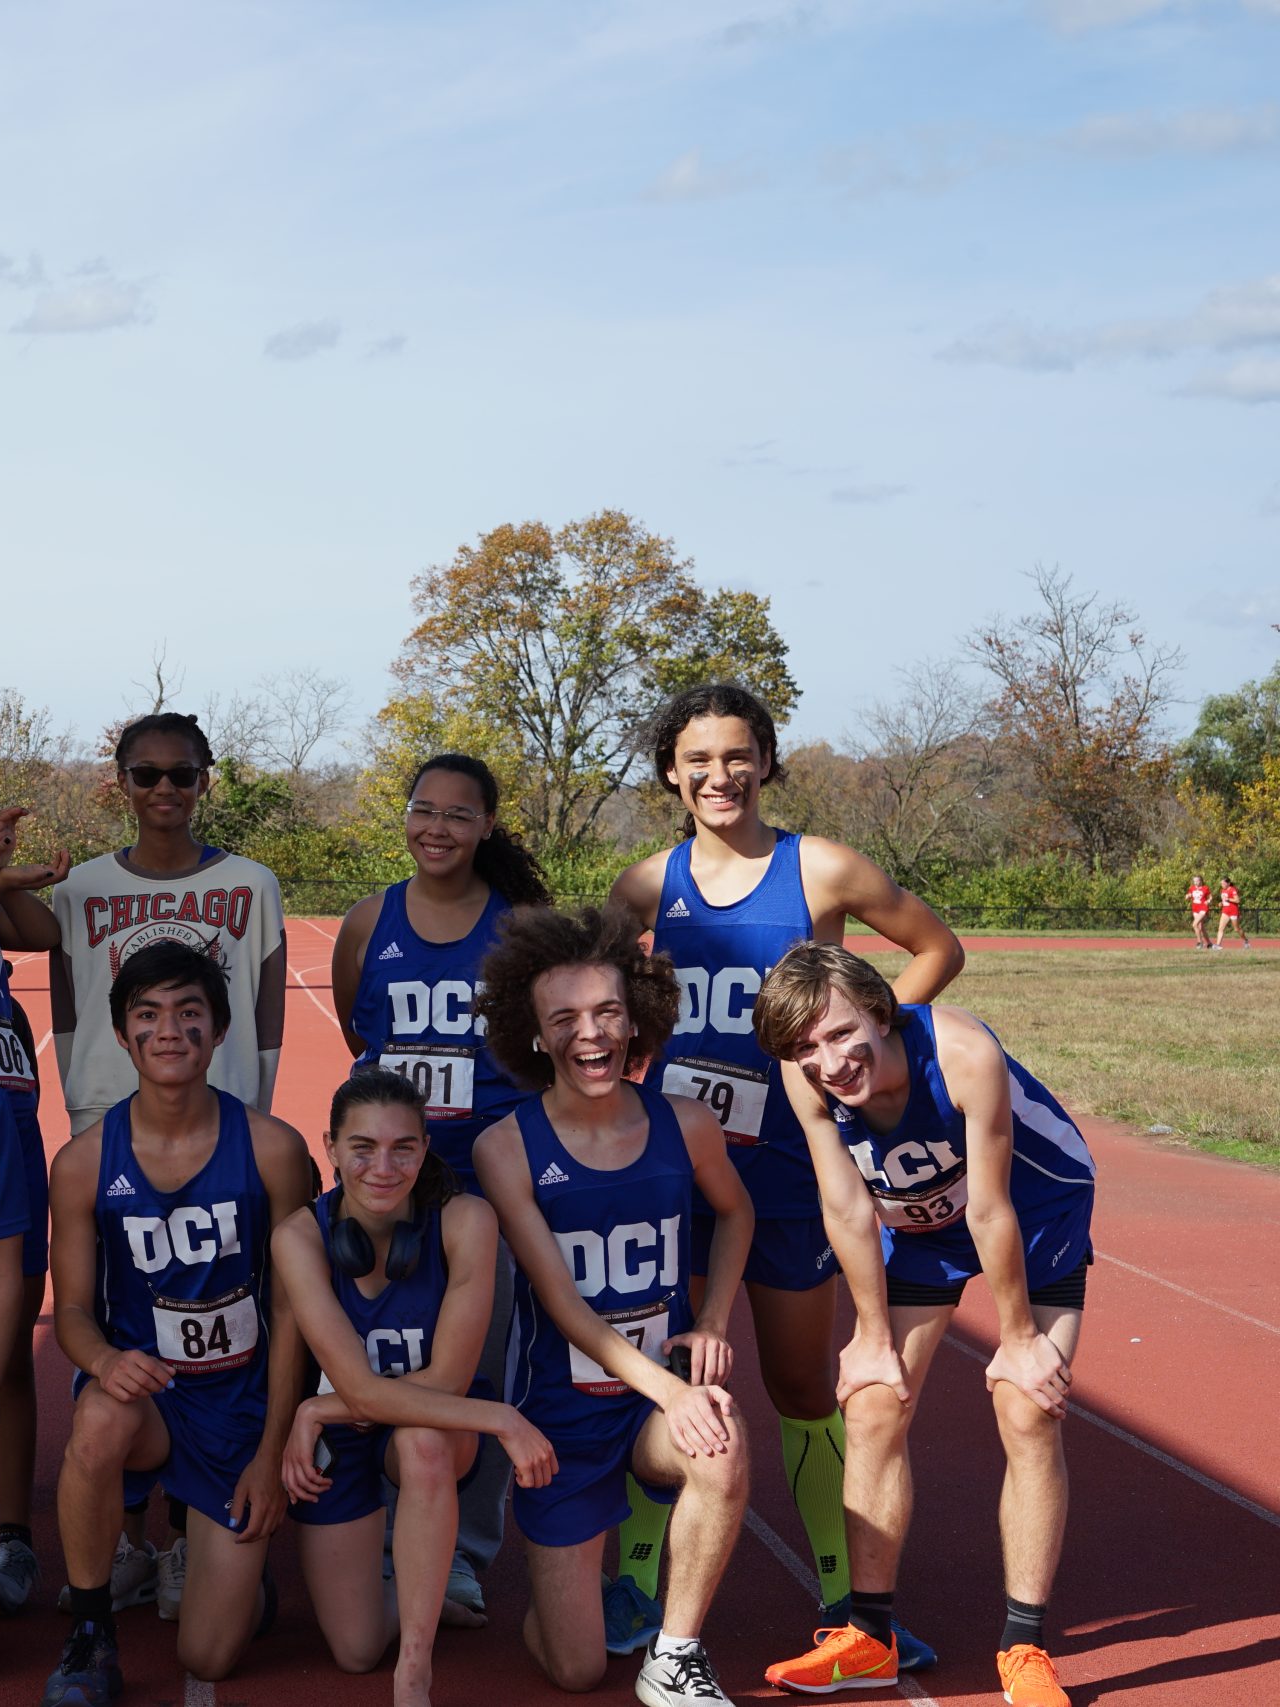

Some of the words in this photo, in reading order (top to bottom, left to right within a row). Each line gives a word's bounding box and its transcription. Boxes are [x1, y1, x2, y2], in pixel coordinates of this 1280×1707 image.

[84, 886, 253, 949] CHICAGO
[124, 926, 192, 958] TABLISHED
[379, 951, 403, 960] adidas
[672, 966, 773, 1035] DC
[691, 1075, 734, 1127] 79
[107, 1187, 136, 1197] adidas
[539, 1174, 569, 1186] adidas
[904, 1195, 954, 1224] 93
[123, 1201, 241, 1273] DCI
[551, 1214, 681, 1297] DCI
[181, 1314, 232, 1359] 84
[358, 1328, 424, 1376] CI
